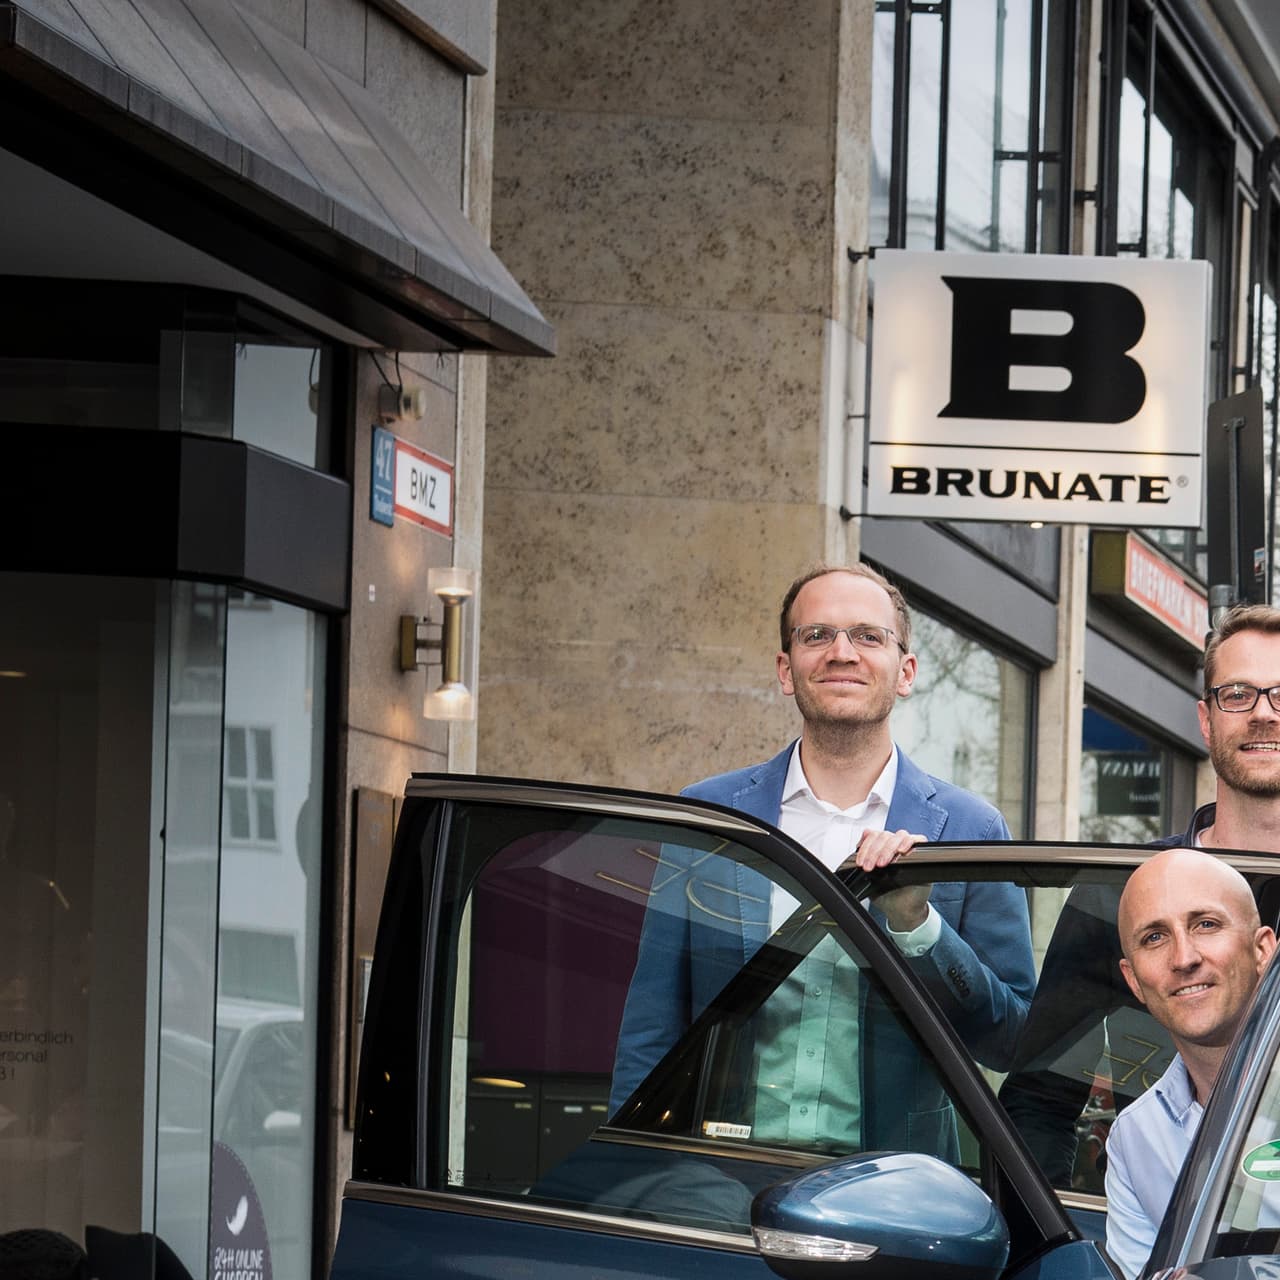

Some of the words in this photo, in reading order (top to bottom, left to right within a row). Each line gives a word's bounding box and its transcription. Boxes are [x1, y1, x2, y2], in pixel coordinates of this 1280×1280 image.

[937, 275, 1146, 424] B
[376, 437, 392, 480] 47
[410, 467, 437, 510] BMZ
[890, 465, 1171, 504] BRUNATE
[236, 1248, 264, 1270] ONLINE
